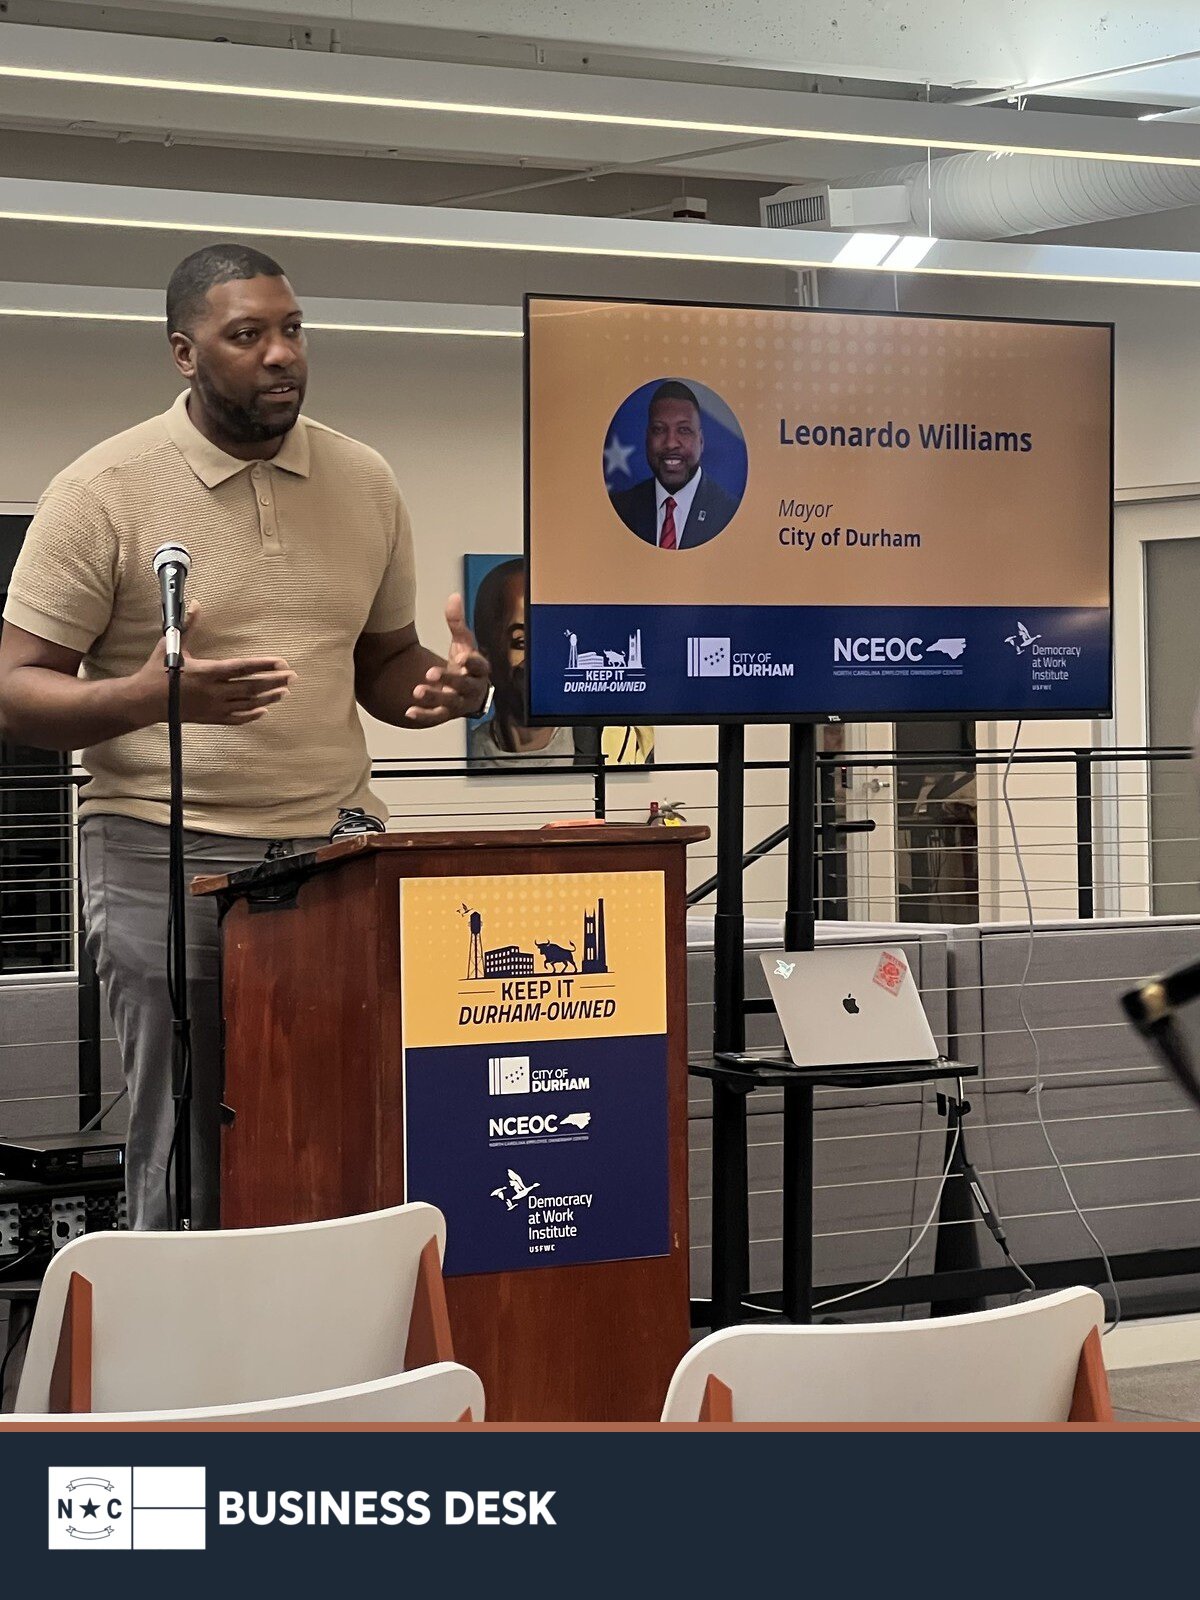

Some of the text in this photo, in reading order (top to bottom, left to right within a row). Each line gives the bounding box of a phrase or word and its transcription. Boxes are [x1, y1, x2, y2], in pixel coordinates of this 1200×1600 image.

[780, 418, 1033, 452] Leonardo Williams
[778, 499, 834, 523] Mayor
[779, 527, 921, 551] City of Durham
[833, 637, 923, 662] NCEOC
[1032, 644, 1082, 658] Democracy
[732, 652, 772, 664] CITY OF
[1032, 657, 1067, 668] at Work
[585, 670, 625, 681] KEEP IT
[732, 663, 794, 677] DURHAM
[1032, 669, 1069, 680] Institute
[563, 681, 647, 693] DURHAM-OWNED
[501, 979, 575, 1001] KEEP IT
[458, 998, 617, 1026] DURHAM-OWNED
[531, 1068, 569, 1080] CITY OF
[531, 1077, 590, 1093] DURHAM
[489, 1113, 558, 1137] NCEOC
[528, 1193, 593, 1209] Democracy
[528, 1208, 574, 1225] at Work
[528, 1225, 577, 1240] Institute
[529, 1244, 556, 1253] USFWC
